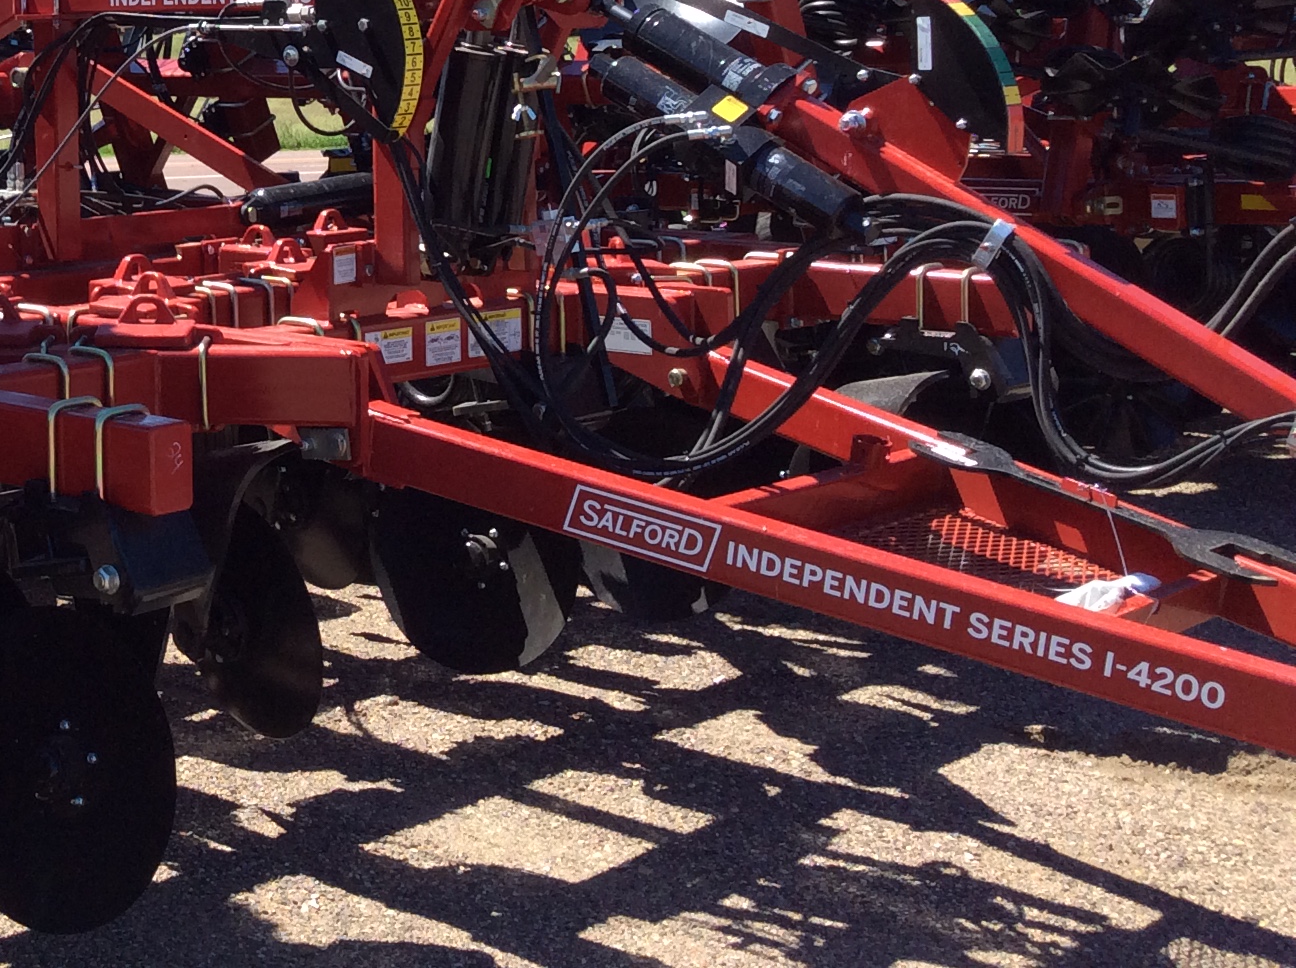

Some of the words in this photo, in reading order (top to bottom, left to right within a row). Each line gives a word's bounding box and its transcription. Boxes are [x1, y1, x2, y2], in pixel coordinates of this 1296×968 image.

[404, 11, 412, 22] 9
[408, 26, 415, 37] 8
[410, 42, 416, 52] 7
[411, 56, 417, 68] 6
[410, 72, 416, 83] 5
[407, 87, 414, 98] 4
[404, 102, 411, 113] 3
[398, 116, 407, 126] 2
[579, 499, 704, 557] SALFORD
[726, 541, 961, 630] INDEPENDENT
[967, 612, 1093, 670] SERIES
[1104, 651, 1226, 709] I-4200
